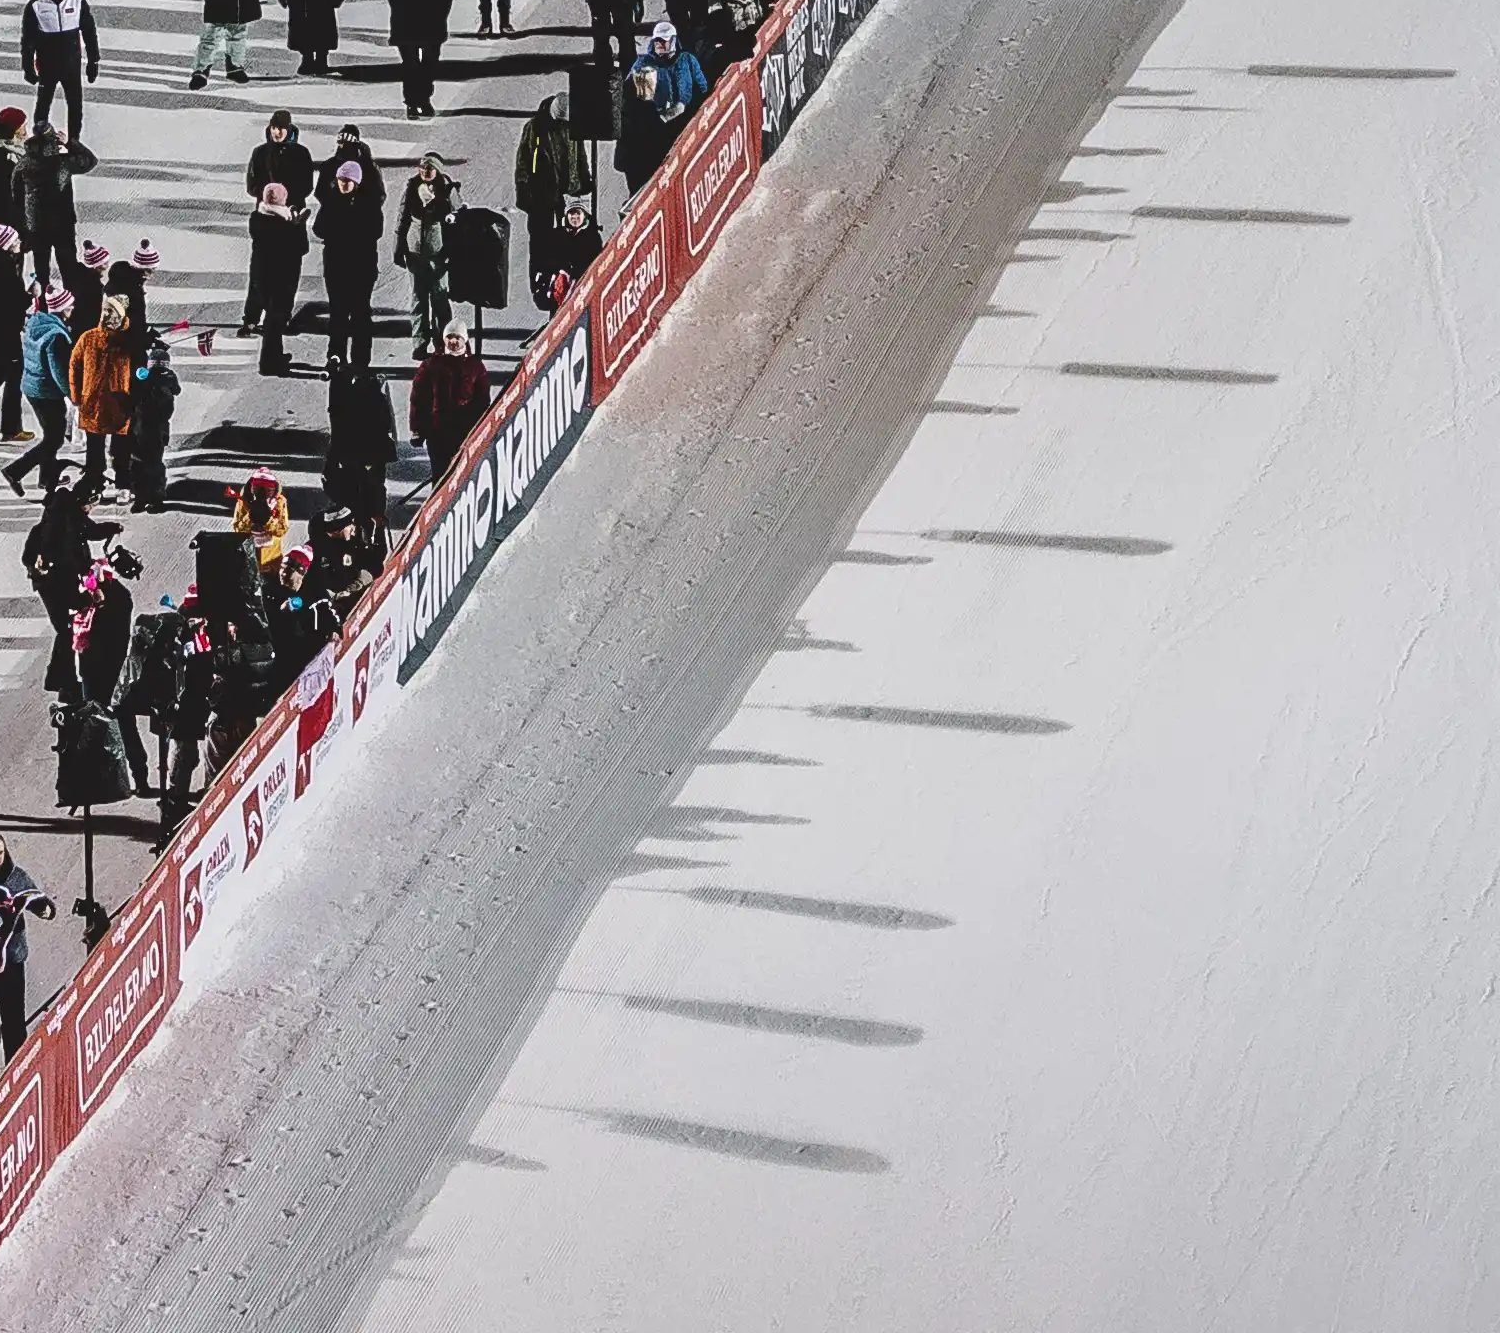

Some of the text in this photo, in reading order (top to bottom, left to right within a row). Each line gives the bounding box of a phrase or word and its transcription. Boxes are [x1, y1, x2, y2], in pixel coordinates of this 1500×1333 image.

[690, 126, 743, 223] BILDELER.NO
[605, 244, 660, 344] BILDELER.NO
[496, 327, 587, 523] Nammo
[400, 459, 493, 665] Nammo
[264, 758, 286, 802] ORLEN
[205, 833, 230, 877] ORLEN
[85, 940, 160, 1074] BILDELER.NO
